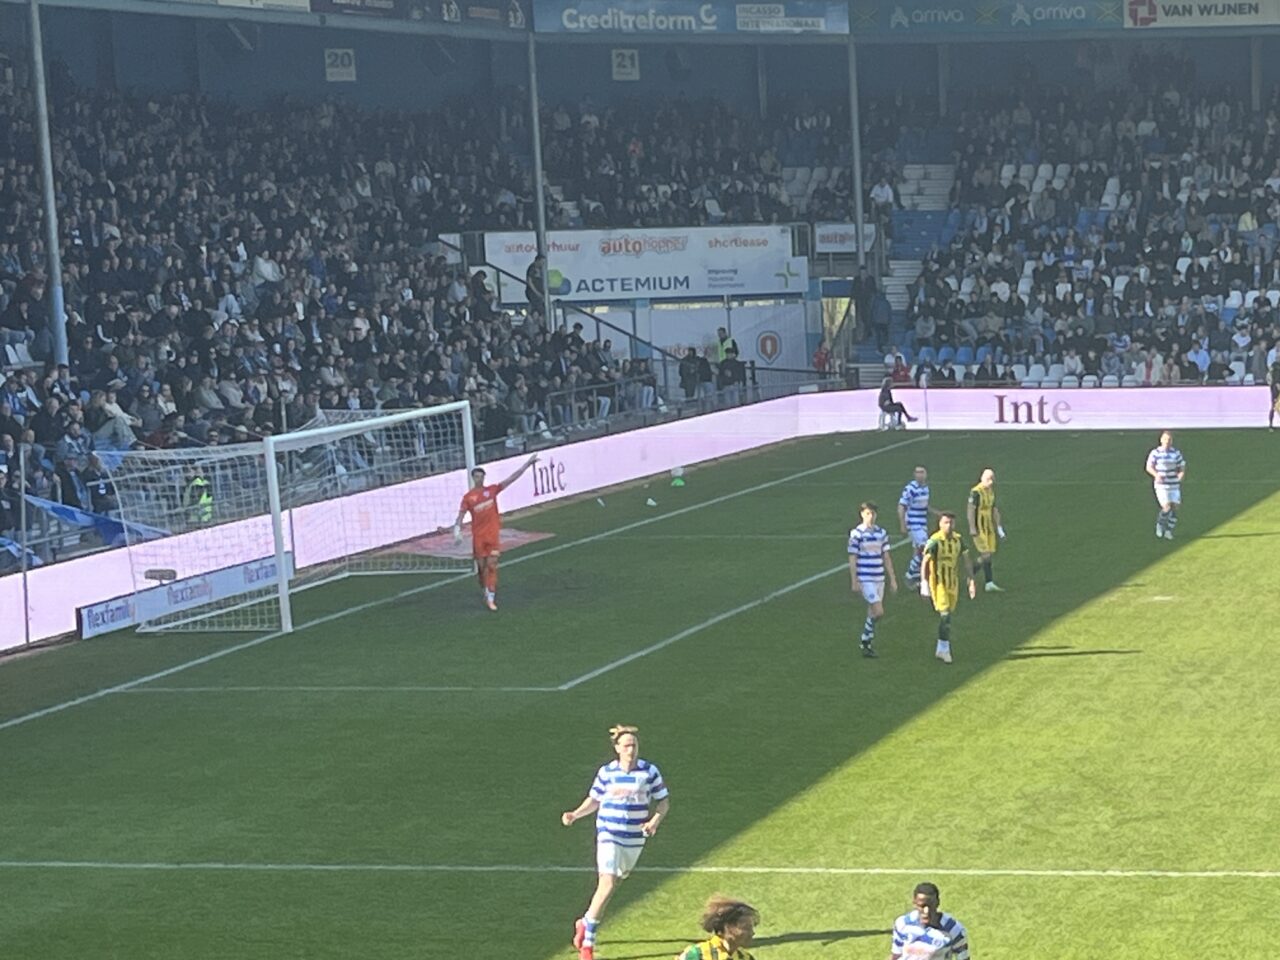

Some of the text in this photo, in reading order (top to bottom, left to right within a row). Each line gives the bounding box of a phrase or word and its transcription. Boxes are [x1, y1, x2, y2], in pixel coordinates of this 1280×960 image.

[912, 6, 965, 23] arriva
[1033, 5, 1086, 21] arriva
[1161, 3, 1259, 17] VAN WIJNEN
[562, 8, 696, 30] Creditreform
[328, 52, 353, 68] 20
[616, 52, 636, 68] 21
[575, 275, 690, 293] ACTEMIUM
[994, 394, 1072, 425] Inte
[532, 457, 567, 497] Inte
[243, 563, 277, 586] flexfam
